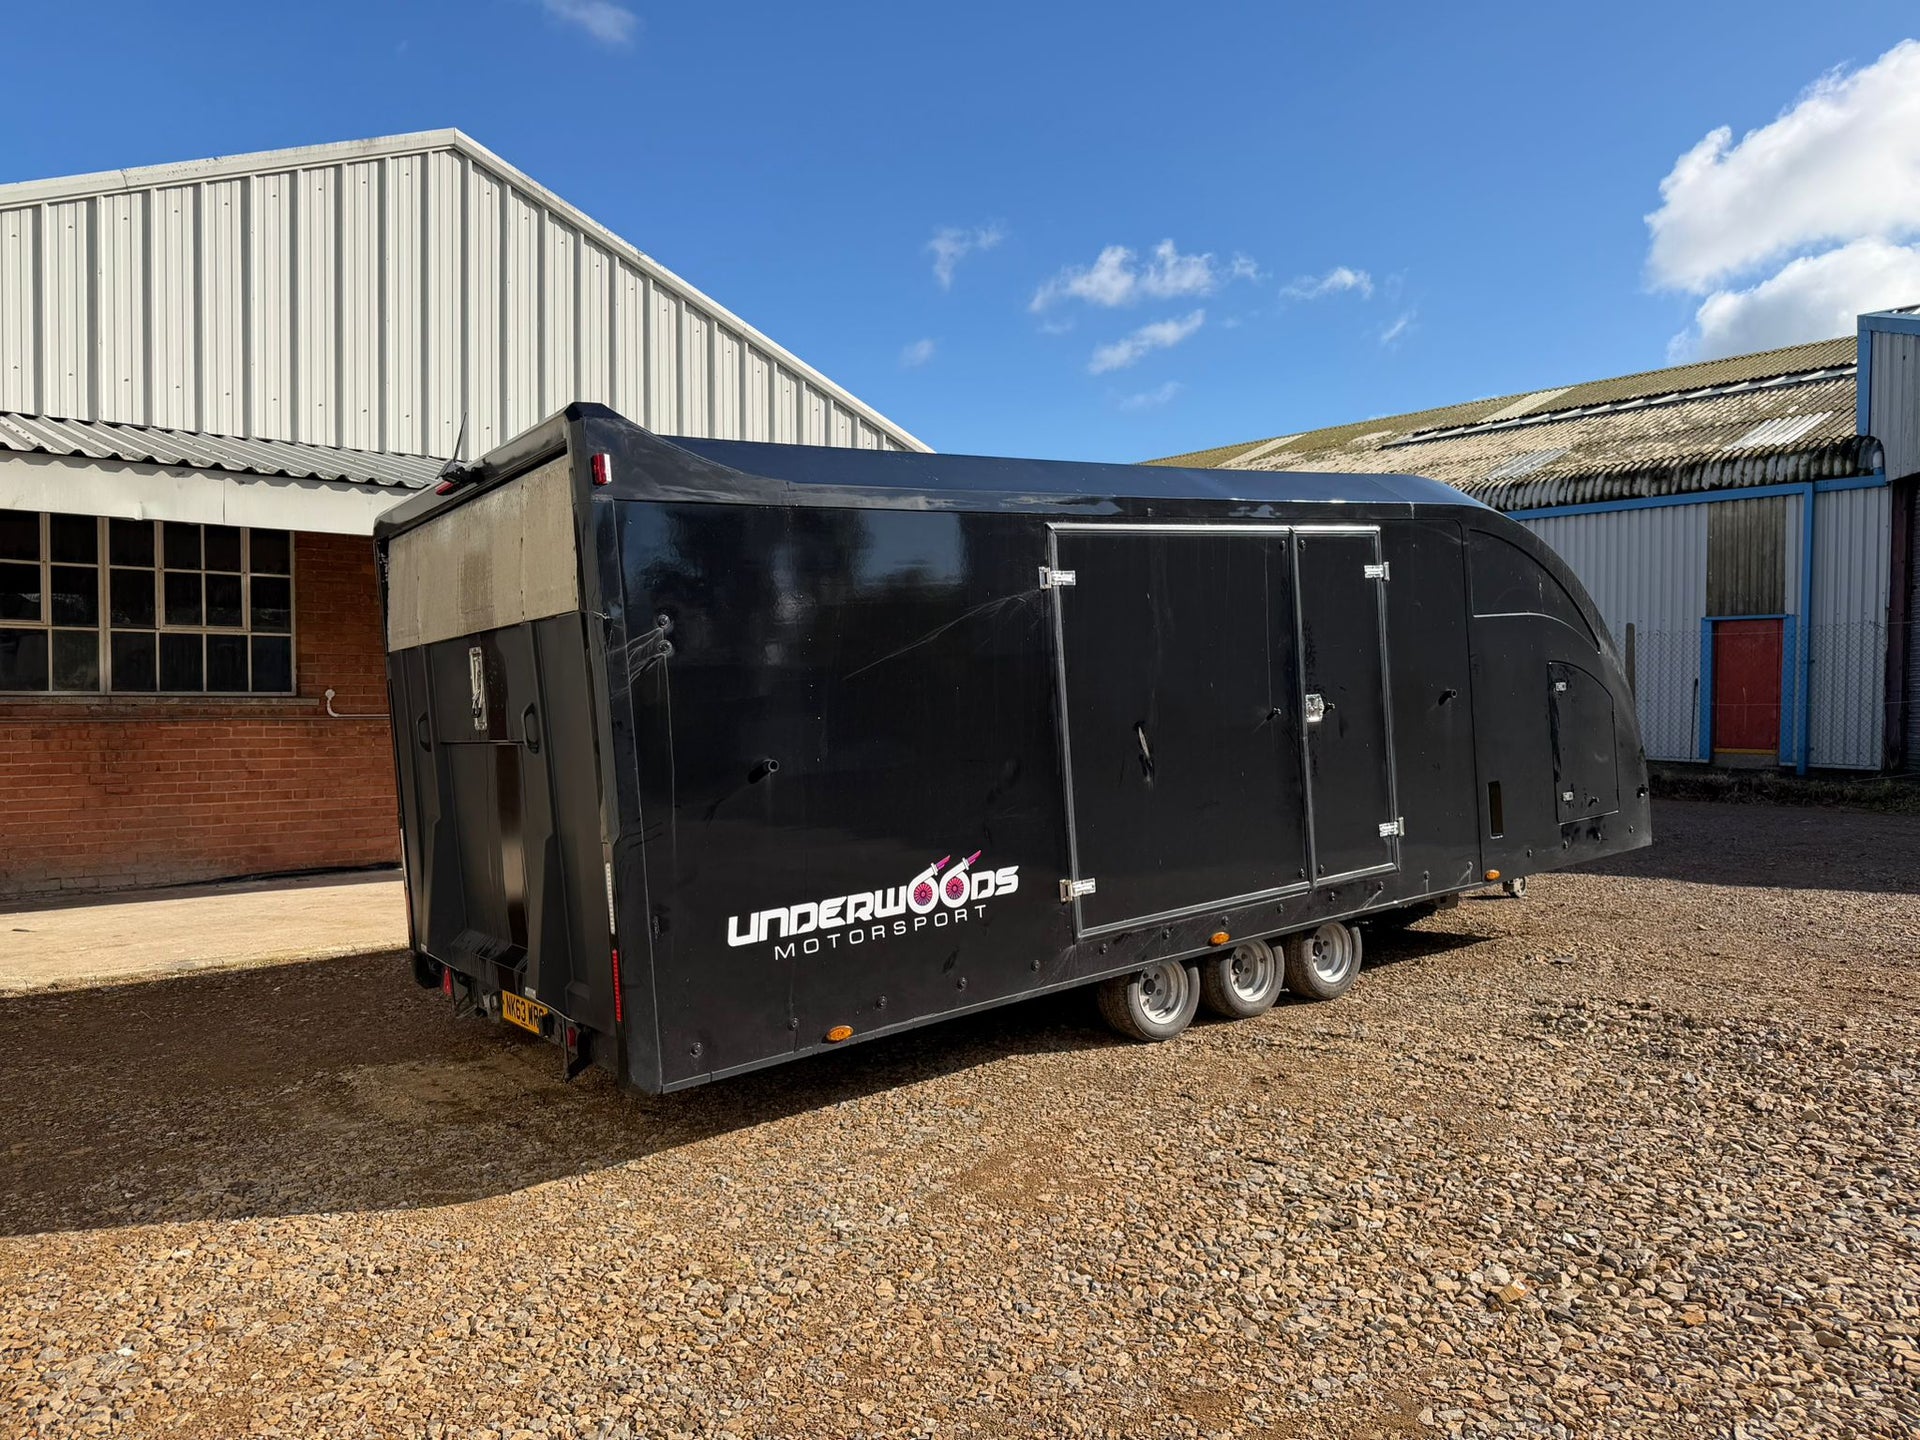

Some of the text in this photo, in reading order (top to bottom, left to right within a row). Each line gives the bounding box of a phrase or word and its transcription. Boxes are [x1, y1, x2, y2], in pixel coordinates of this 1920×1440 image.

[728, 852, 1019, 946] UNDERWOODS
[774, 905, 987, 960] MOTORSPORT
[506, 994, 525, 1022] NK63
